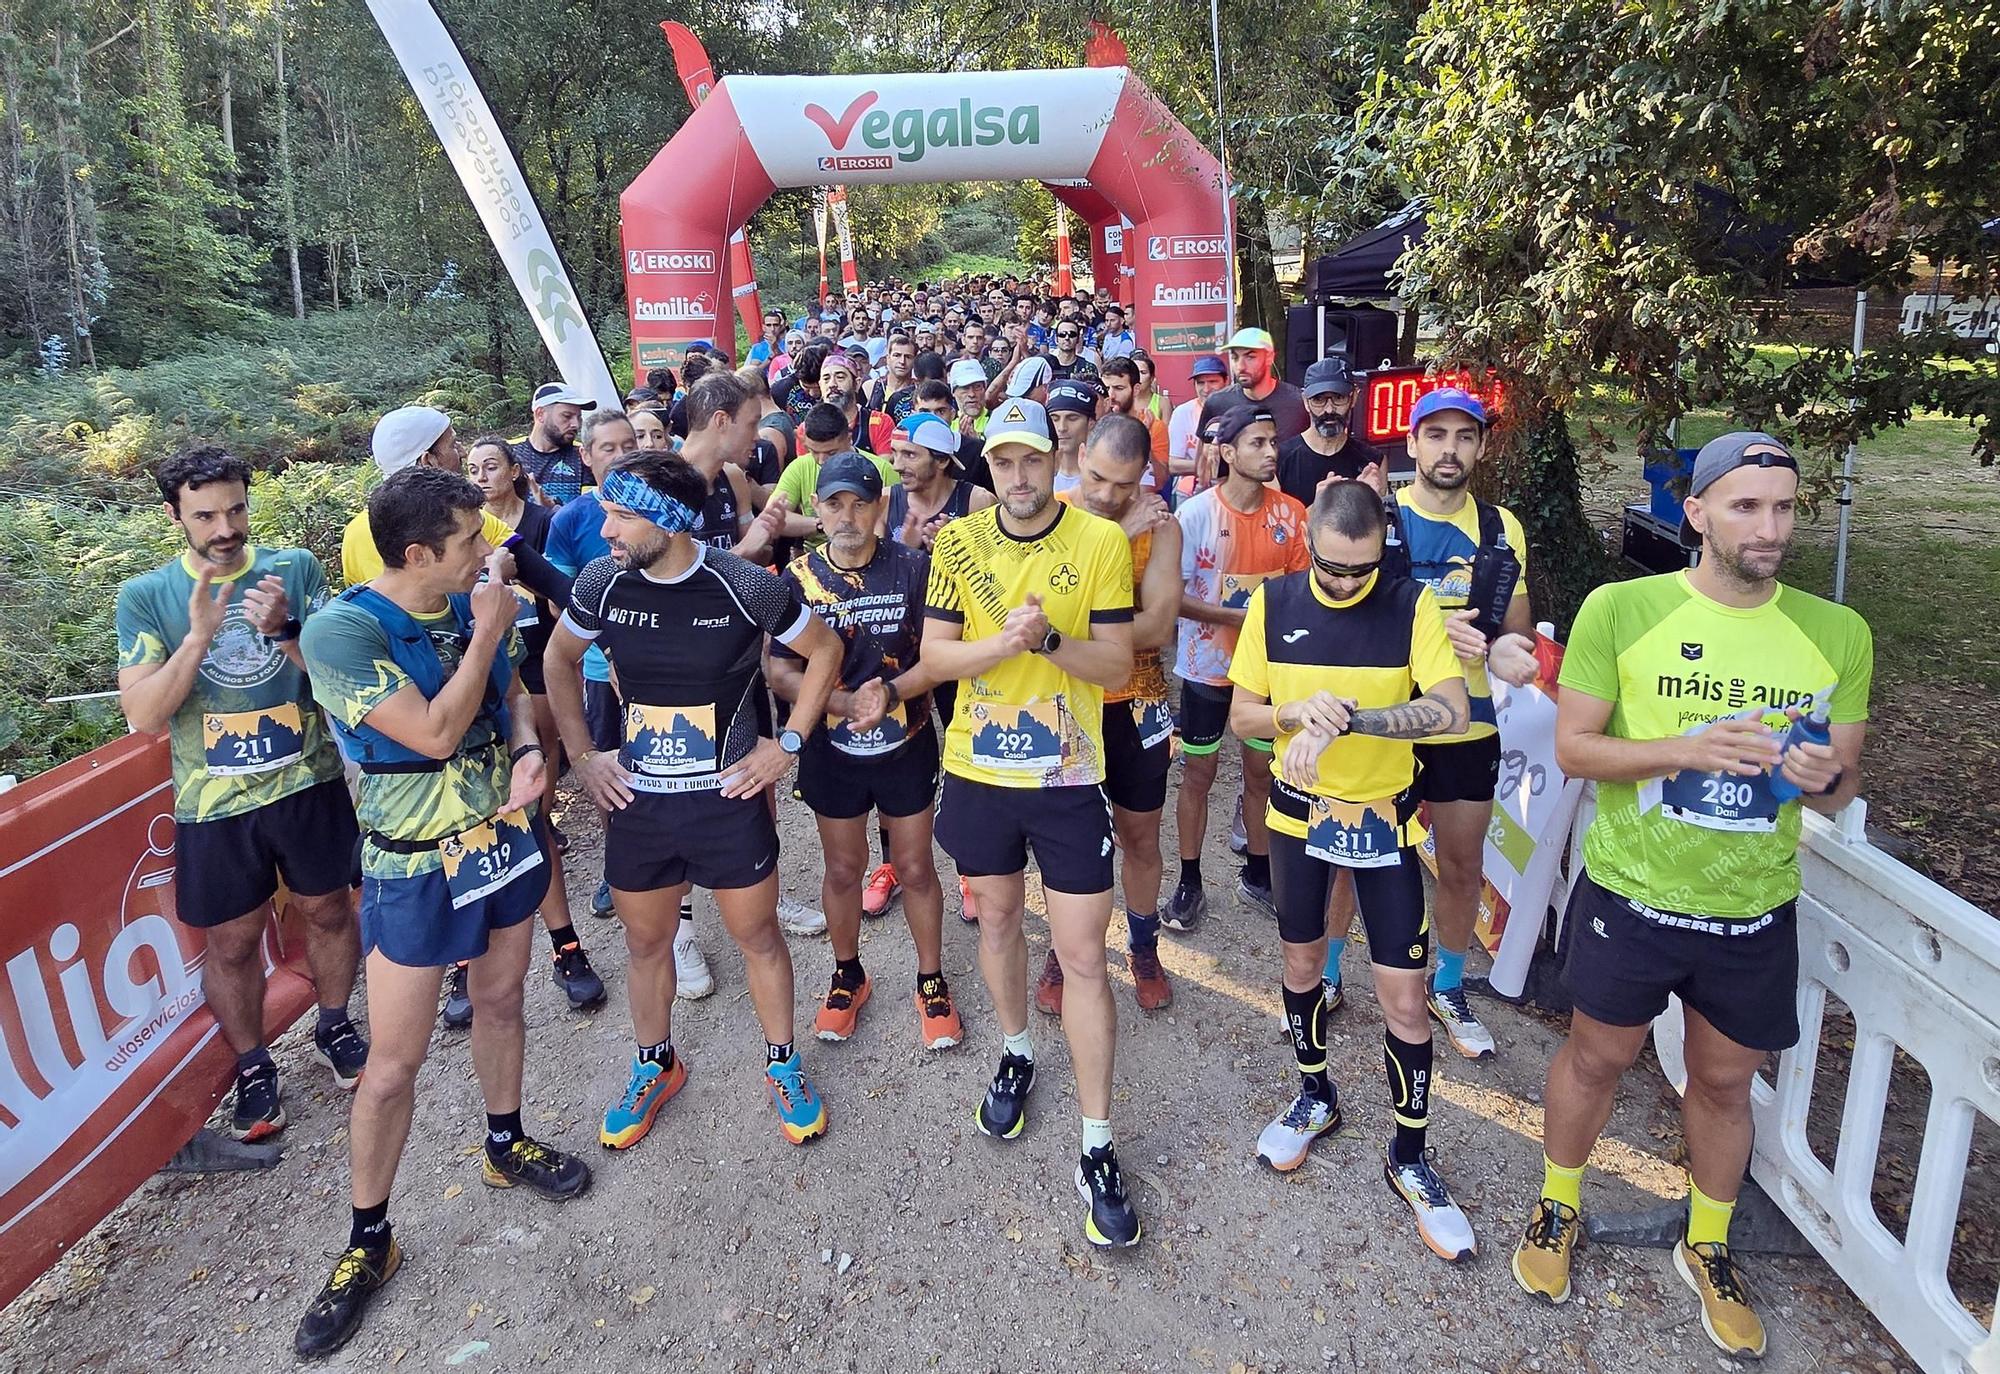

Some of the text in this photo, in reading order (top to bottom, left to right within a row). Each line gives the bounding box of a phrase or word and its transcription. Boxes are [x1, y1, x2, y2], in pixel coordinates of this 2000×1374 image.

[804, 90, 1040, 162] Vegalsa
[839, 157, 890, 170] EROSKI
[1173, 240, 1228, 255] EROSK
[647, 255, 711, 269] EROSKI
[1155, 282, 1222, 301] familia
[635, 297, 704, 315] familia
[1490, 561, 1514, 624] KIPRUN
[829, 593, 904, 613] CORREDORES
[838, 607, 906, 628] INFERNO
[1658, 672, 1814, 716] máis que auga
[233, 738, 273, 758] 211
[650, 737, 687, 757] 285
[996, 733, 1033, 751] 292
[1003, 750, 1027, 759] Casais
[1701, 780, 1753, 807] 280
[1715, 806, 1739, 818] Dani
[1335, 831, 1373, 850] 311
[478, 843, 511, 877] 319
[1329, 845, 1351, 858] Pablo
[1352, 849, 1379, 860] Querol
[1627, 899, 1774, 936] SPHERE PRO
[105, 988, 198, 1072] autoservicios
[1412, 1069, 1426, 1110] SKINS
